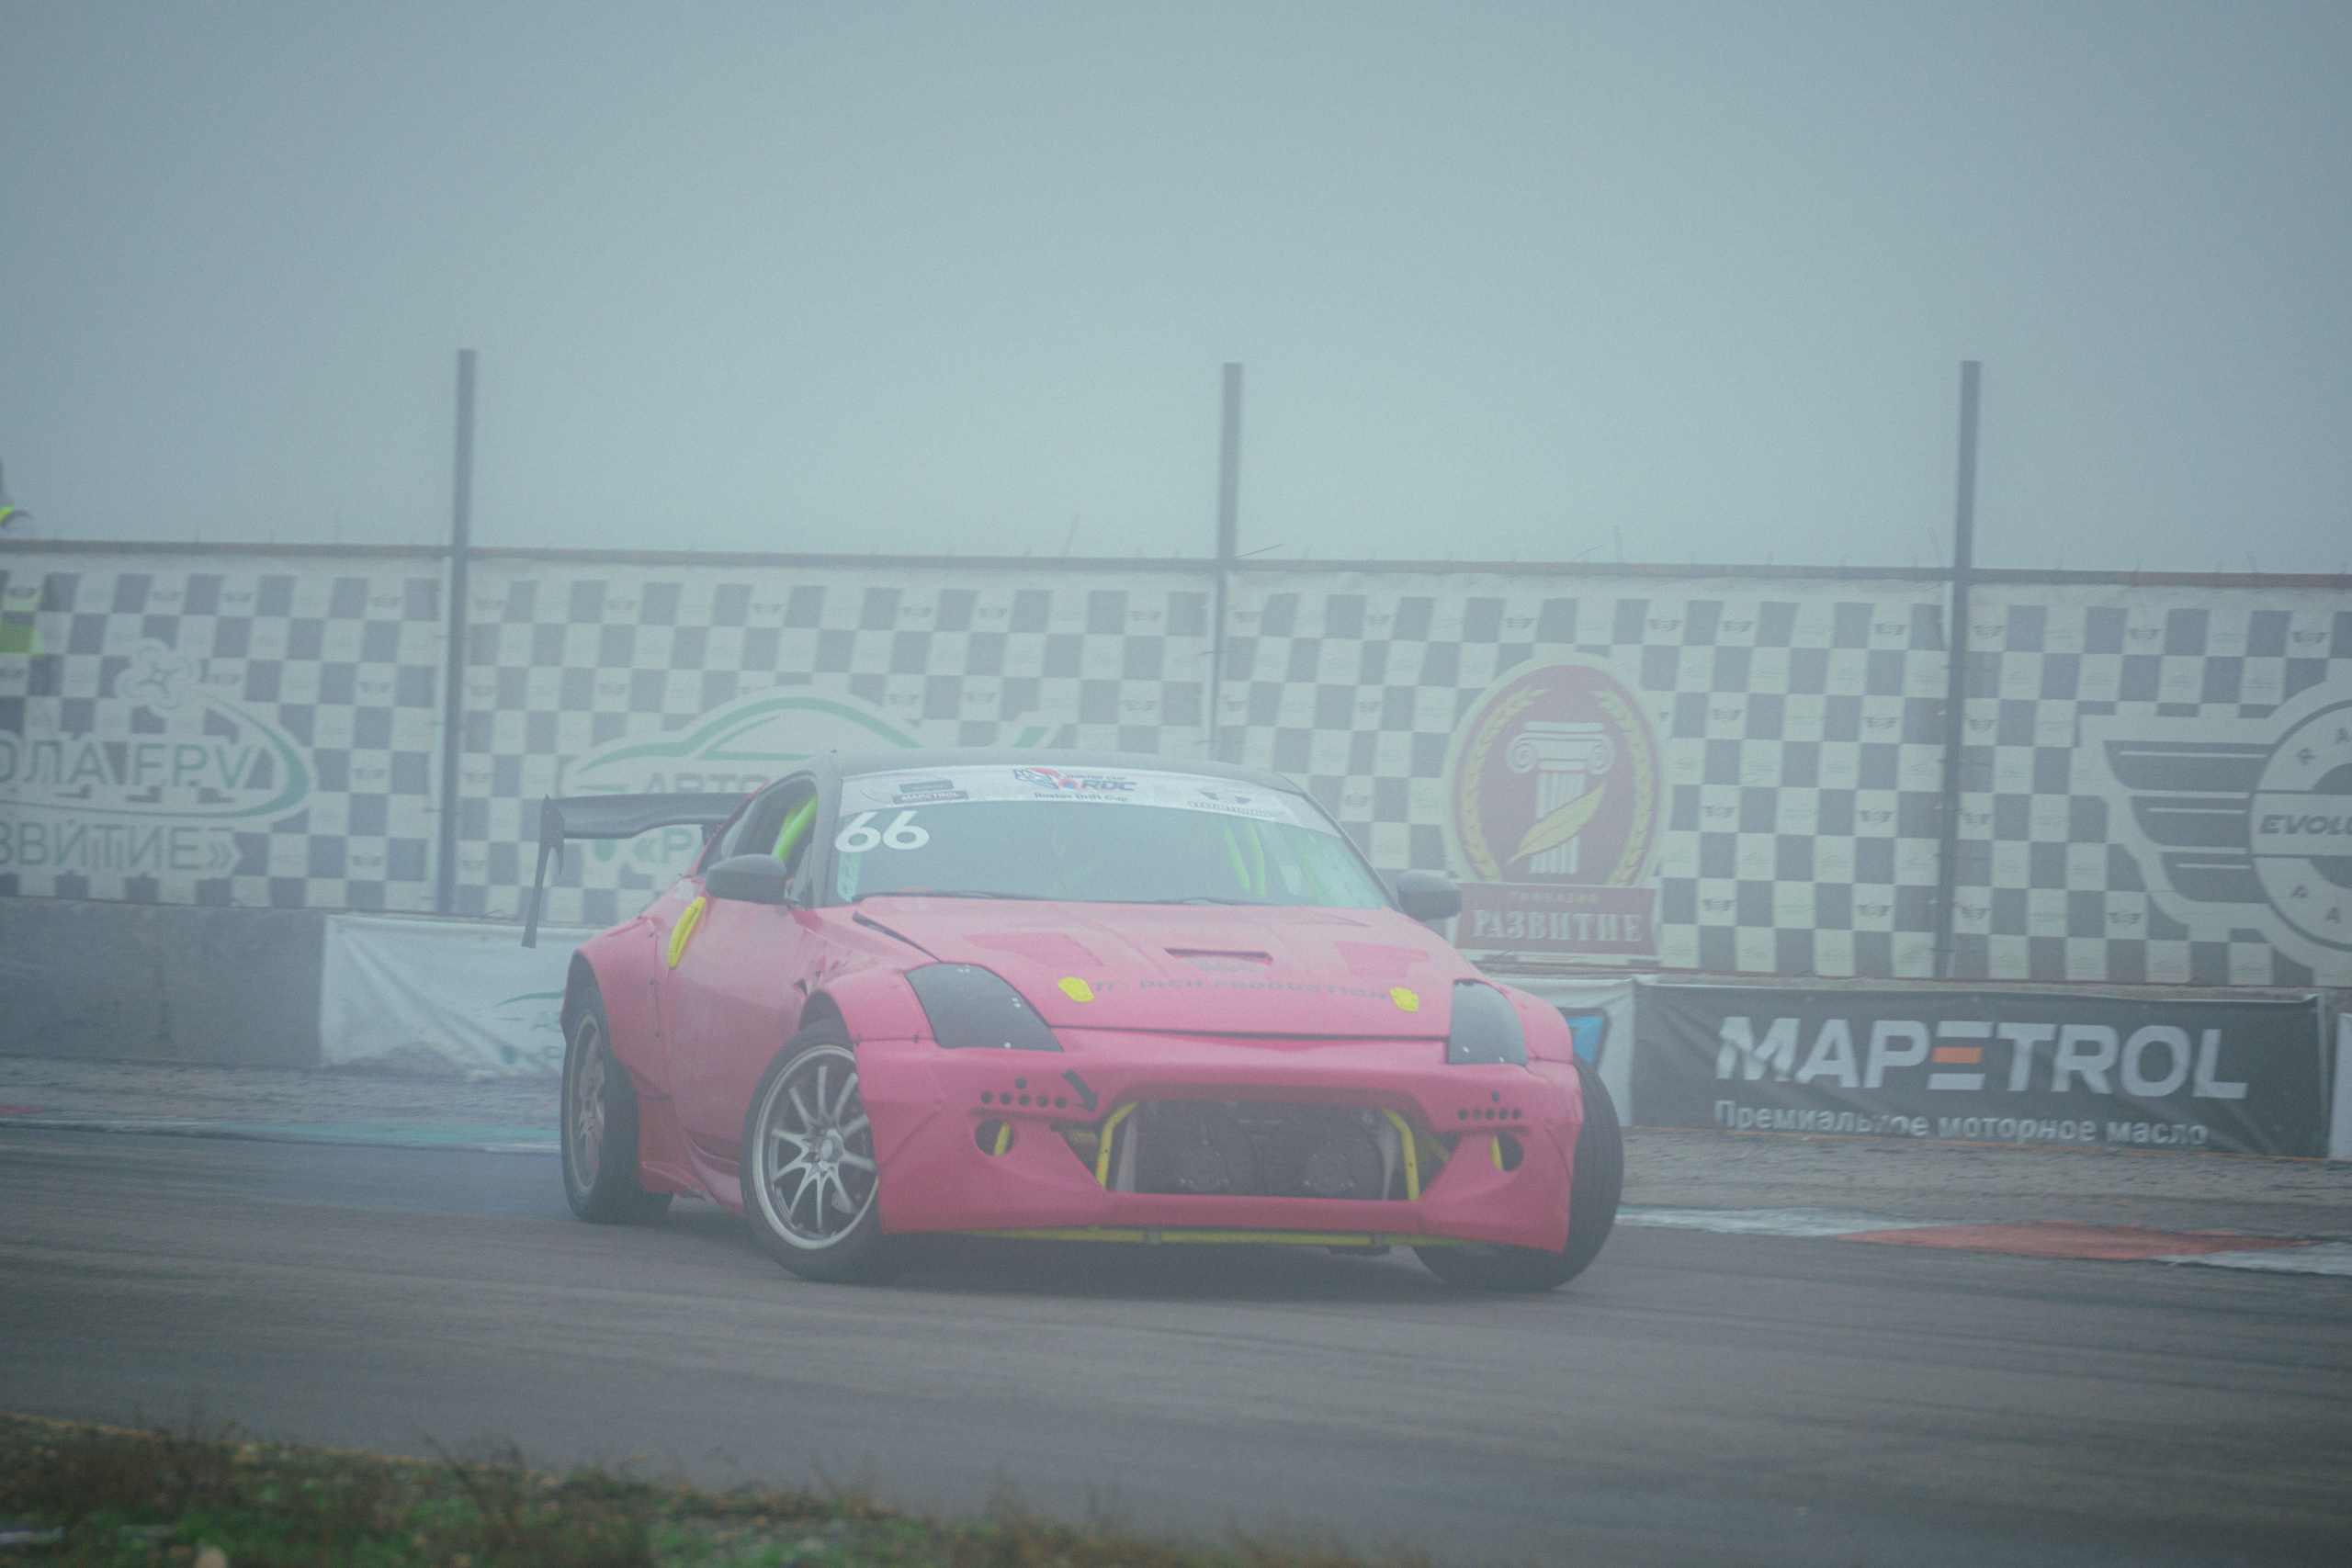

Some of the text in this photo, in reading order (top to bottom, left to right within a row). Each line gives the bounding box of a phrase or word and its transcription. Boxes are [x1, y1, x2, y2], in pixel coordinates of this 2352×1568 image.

[132, 742, 253, 788] FPV
[1076, 792, 1102, 801] Drift
[1104, 794, 1128, 803] Cup
[1081, 780, 1137, 792] RDC
[834, 809, 931, 853] 66
[1472, 908, 1643, 942] РАЗВИТИЕ
[1715, 1015, 2248, 1100] MAPETROL
[1939, 1113, 2097, 1145] моторное
[2106, 1119, 2209, 1145] масло
